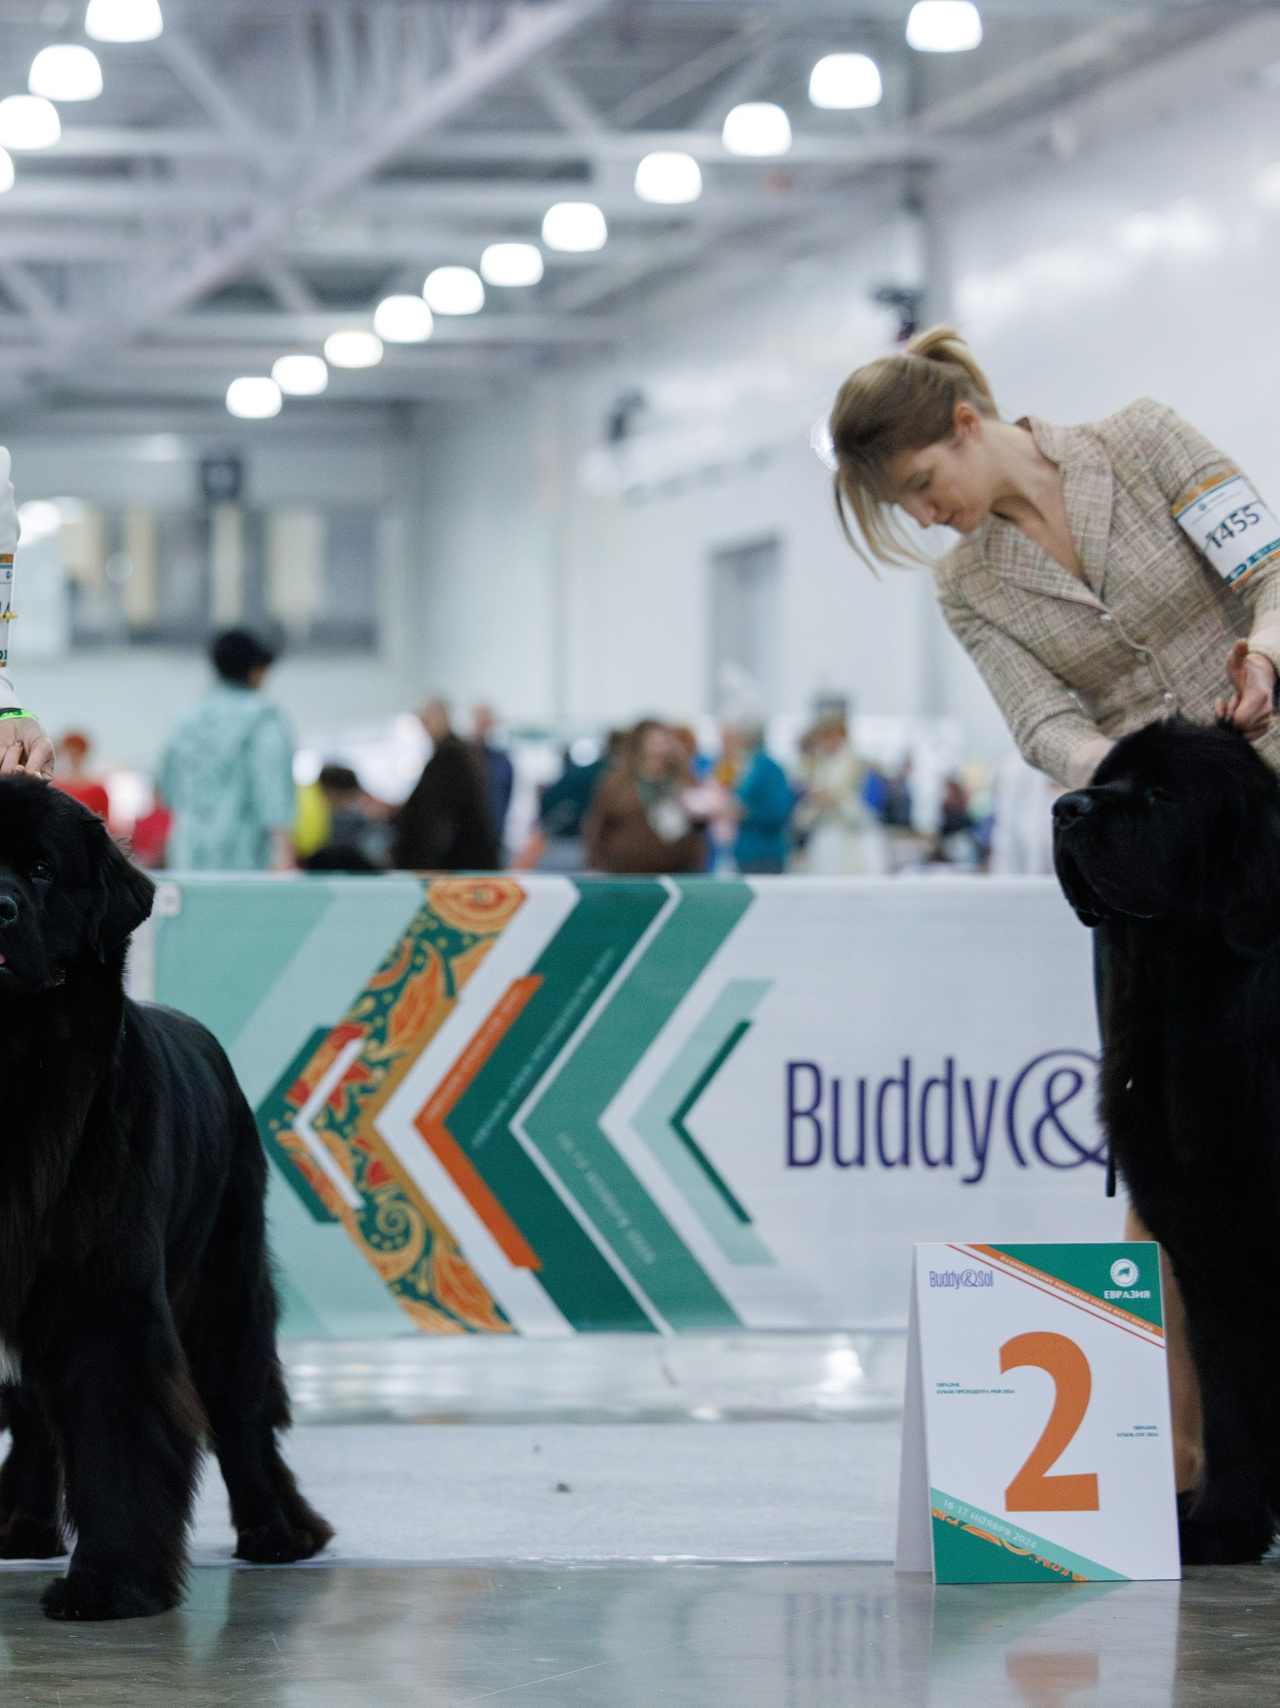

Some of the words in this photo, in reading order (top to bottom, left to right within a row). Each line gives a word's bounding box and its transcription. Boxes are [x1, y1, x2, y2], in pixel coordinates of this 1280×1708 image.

[1205, 505, 1261, 549] 1455
[1103, 1290, 1151, 1300] ЕВРАЗИЯ
[998, 1330, 1100, 1512] 2
[943, 1499, 970, 1516] 1617
[970, 1512, 1012, 1537] НОЯБРЯ
[1012, 1531, 1038, 1549] 2024
